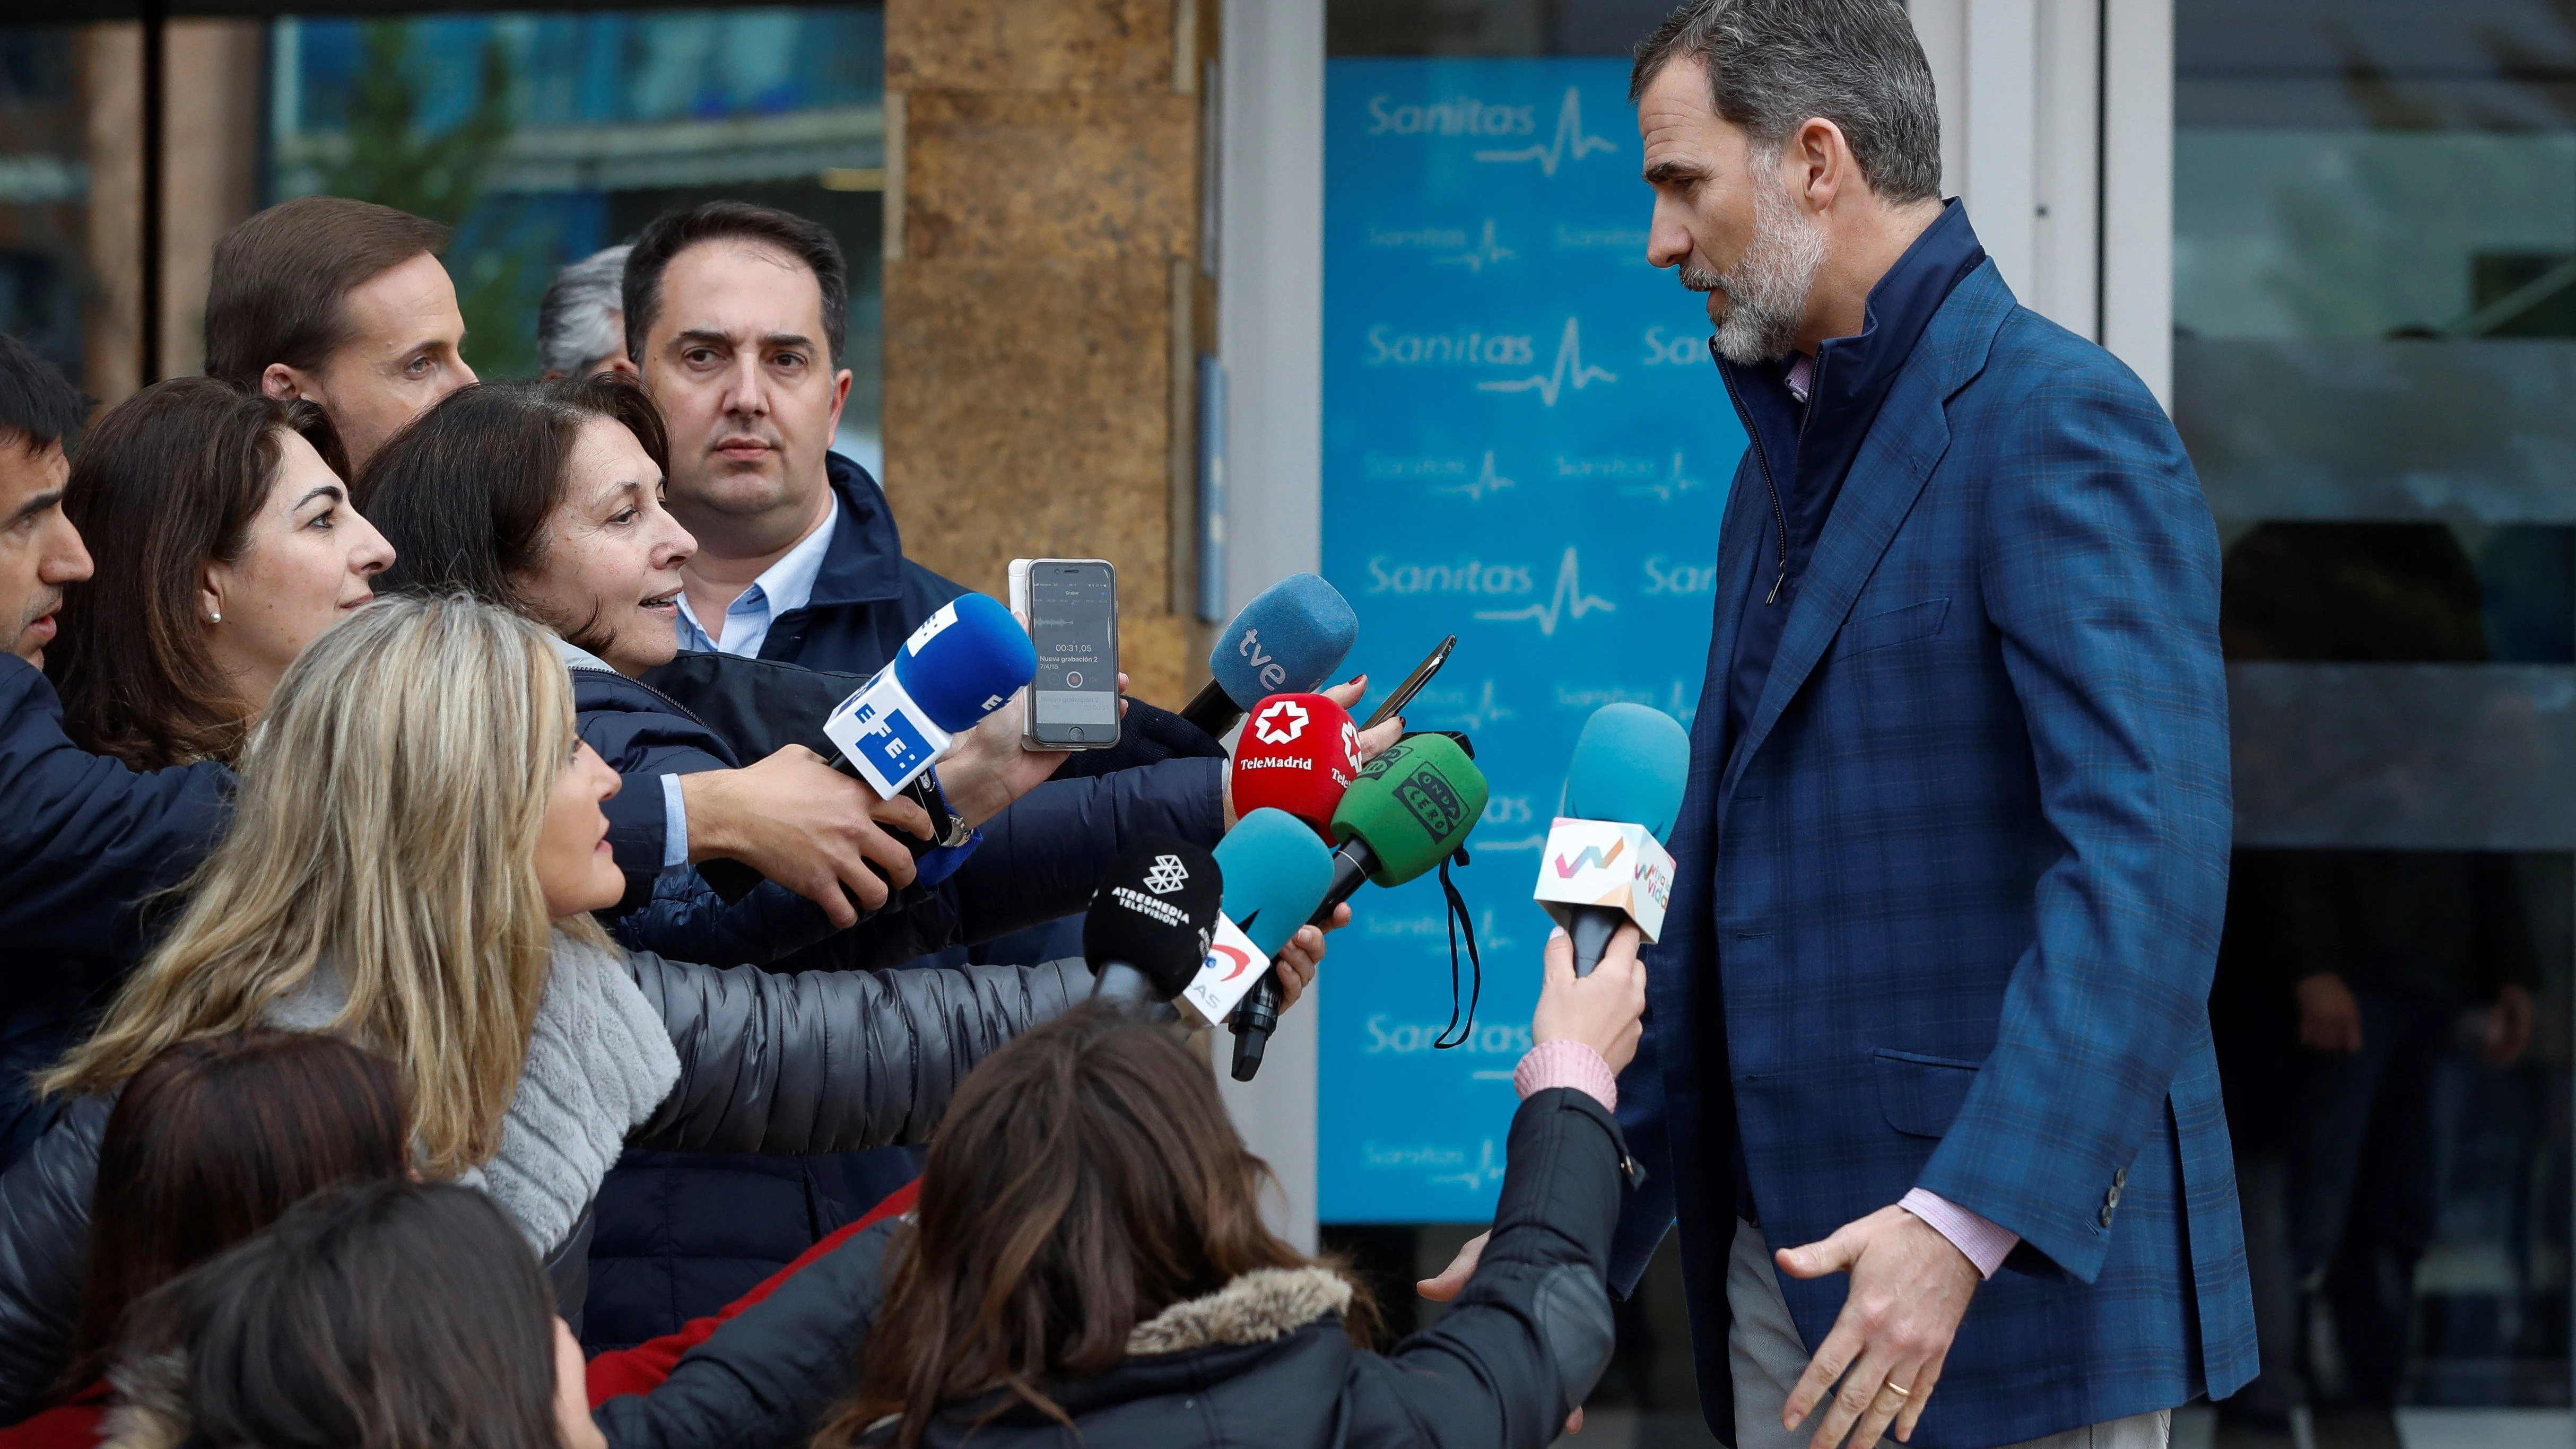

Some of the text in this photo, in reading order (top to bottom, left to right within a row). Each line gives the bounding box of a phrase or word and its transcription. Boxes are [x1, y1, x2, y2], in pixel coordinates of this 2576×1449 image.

[1368, 95, 1536, 136] Sanitas
[1368, 325, 1534, 364] Sanitas
[1368, 556, 1533, 594] Sanitas
[1055, 644, 1092, 653] 00:31,05
[1239, 629, 1286, 691] tve
[1240, 756, 1312, 772] TeleMadrid
[1331, 767, 1351, 789] Tele
[1409, 789, 1446, 829] CERO
[1422, 775, 1457, 816] ONDA
[1111, 886, 1190, 925] ATRESMEDIA
[1119, 897, 1178, 928] TELEVISION
